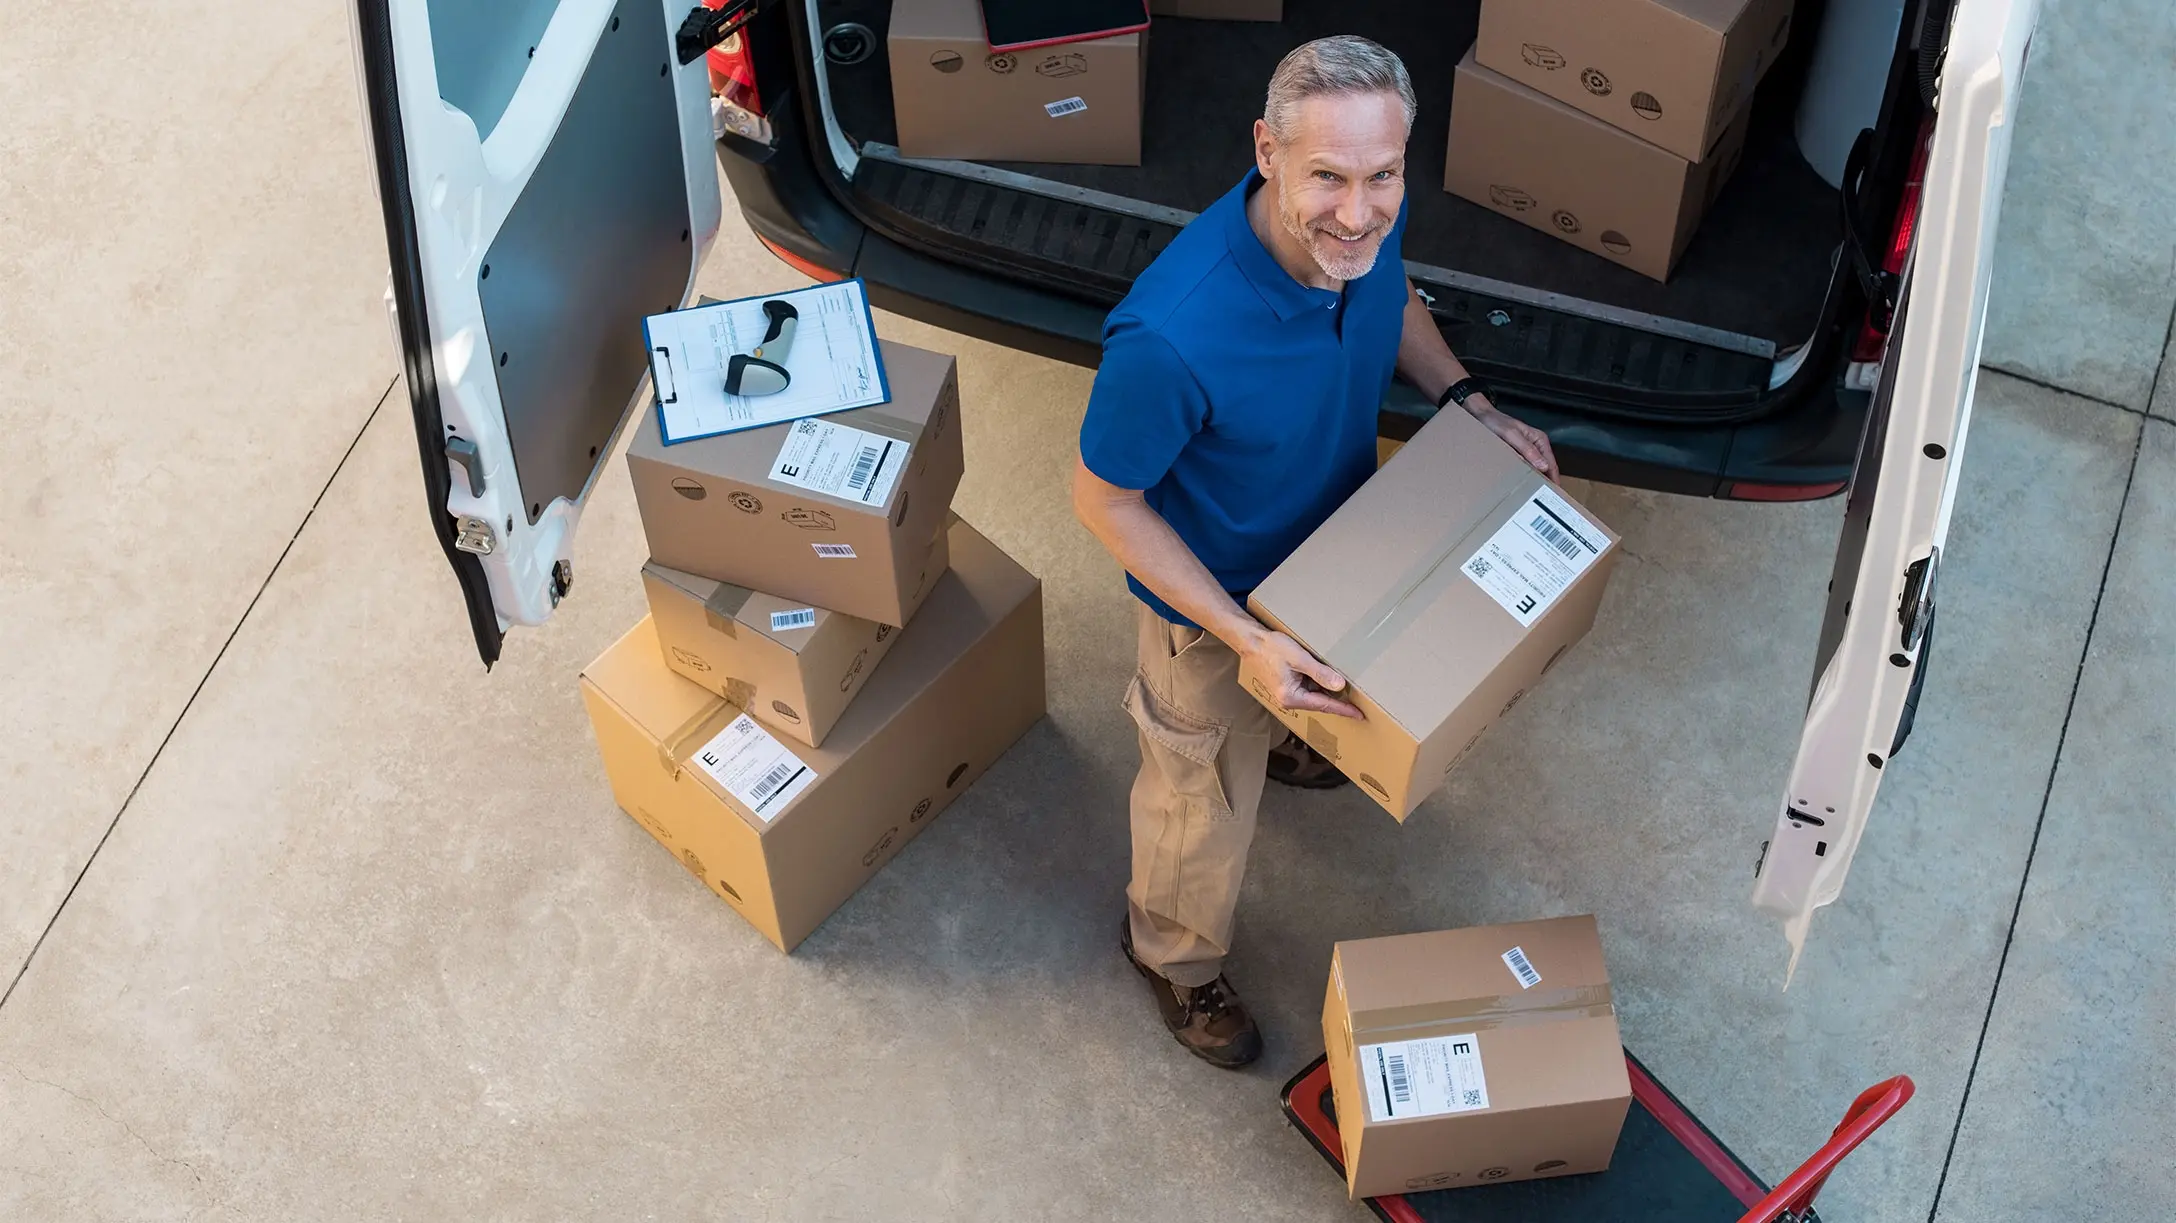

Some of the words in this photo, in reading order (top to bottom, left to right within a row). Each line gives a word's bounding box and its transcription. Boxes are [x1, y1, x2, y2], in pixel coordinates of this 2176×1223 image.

[780, 464, 799, 477] E
[1501, 558, 1520, 575] EXPRESS
[1519, 573, 1529, 583] MAIL
[1528, 581, 1547, 598] PRIORITY
[1516, 595, 1537, 614] E
[702, 752, 719, 766] E
[1453, 1043, 1469, 1055] E
